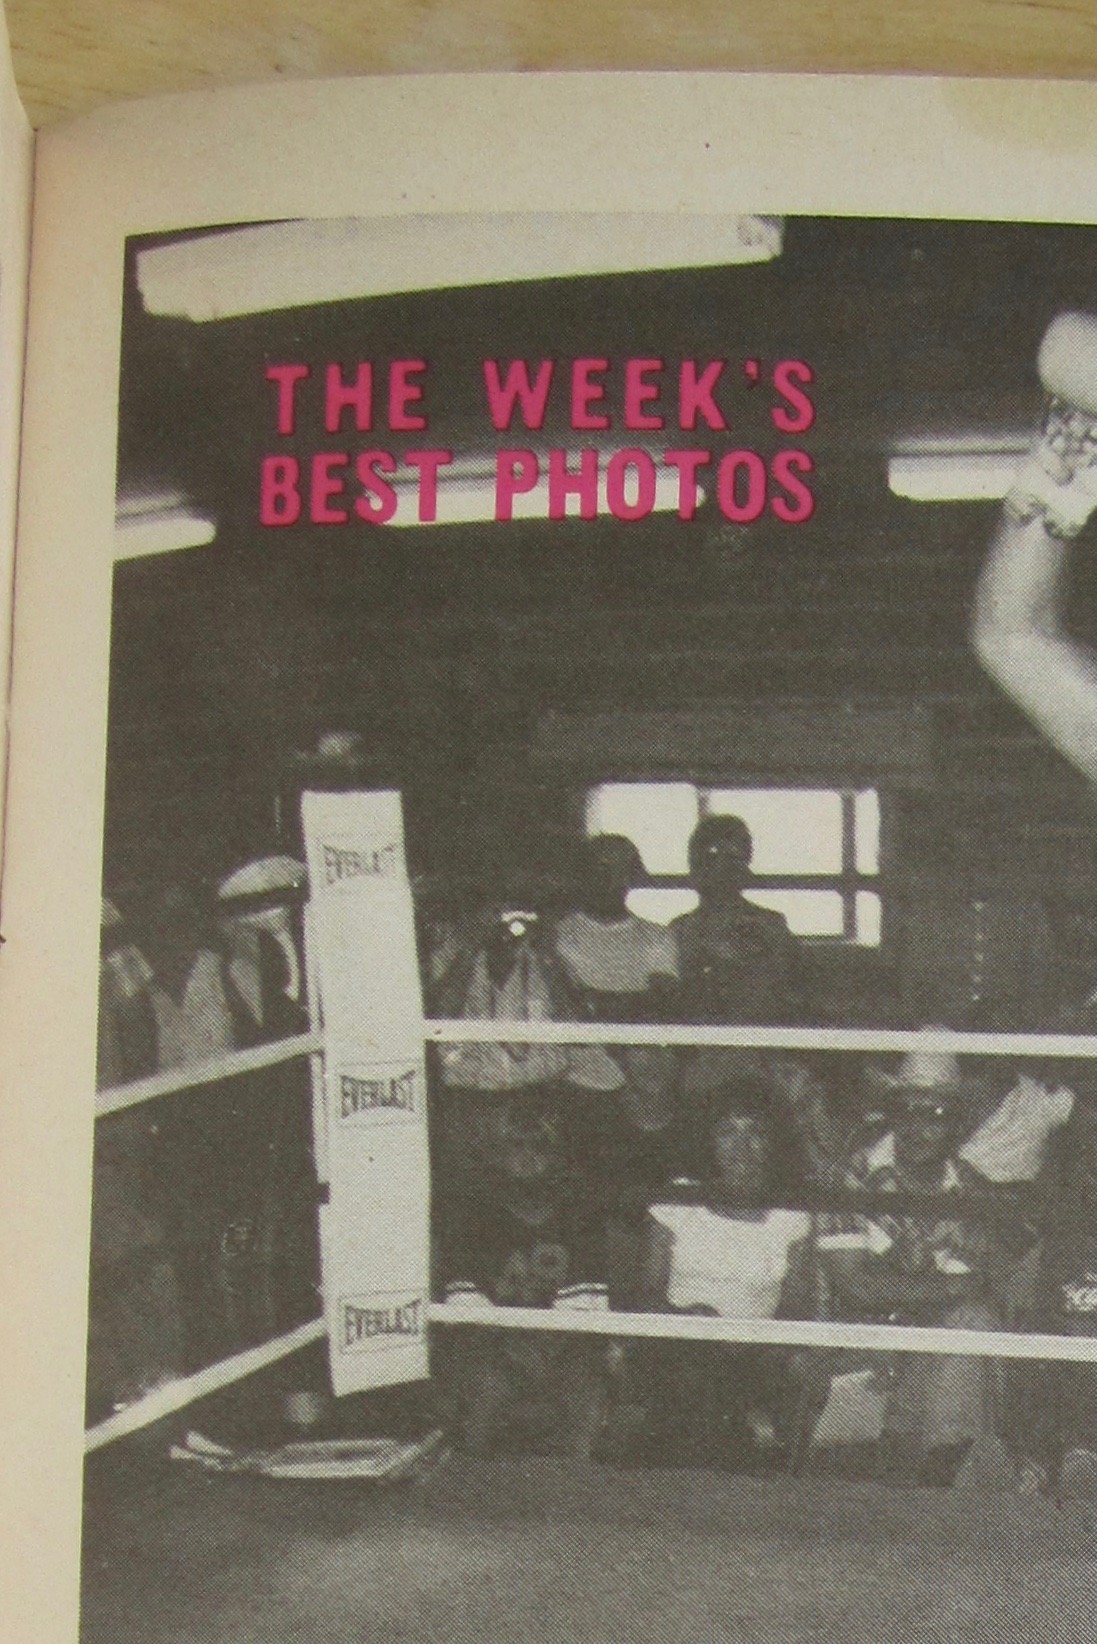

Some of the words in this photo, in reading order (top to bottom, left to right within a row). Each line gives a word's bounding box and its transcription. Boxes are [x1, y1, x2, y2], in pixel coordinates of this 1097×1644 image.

[264, 357, 429, 437] THE
[481, 356, 817, 437] WEEK'S
[257, 448, 454, 529] BEST
[495, 447, 817, 526] PHOTOS
[340, 1068, 417, 1120] EVERLAST
[344, 1297, 422, 1346] EVERLAST
